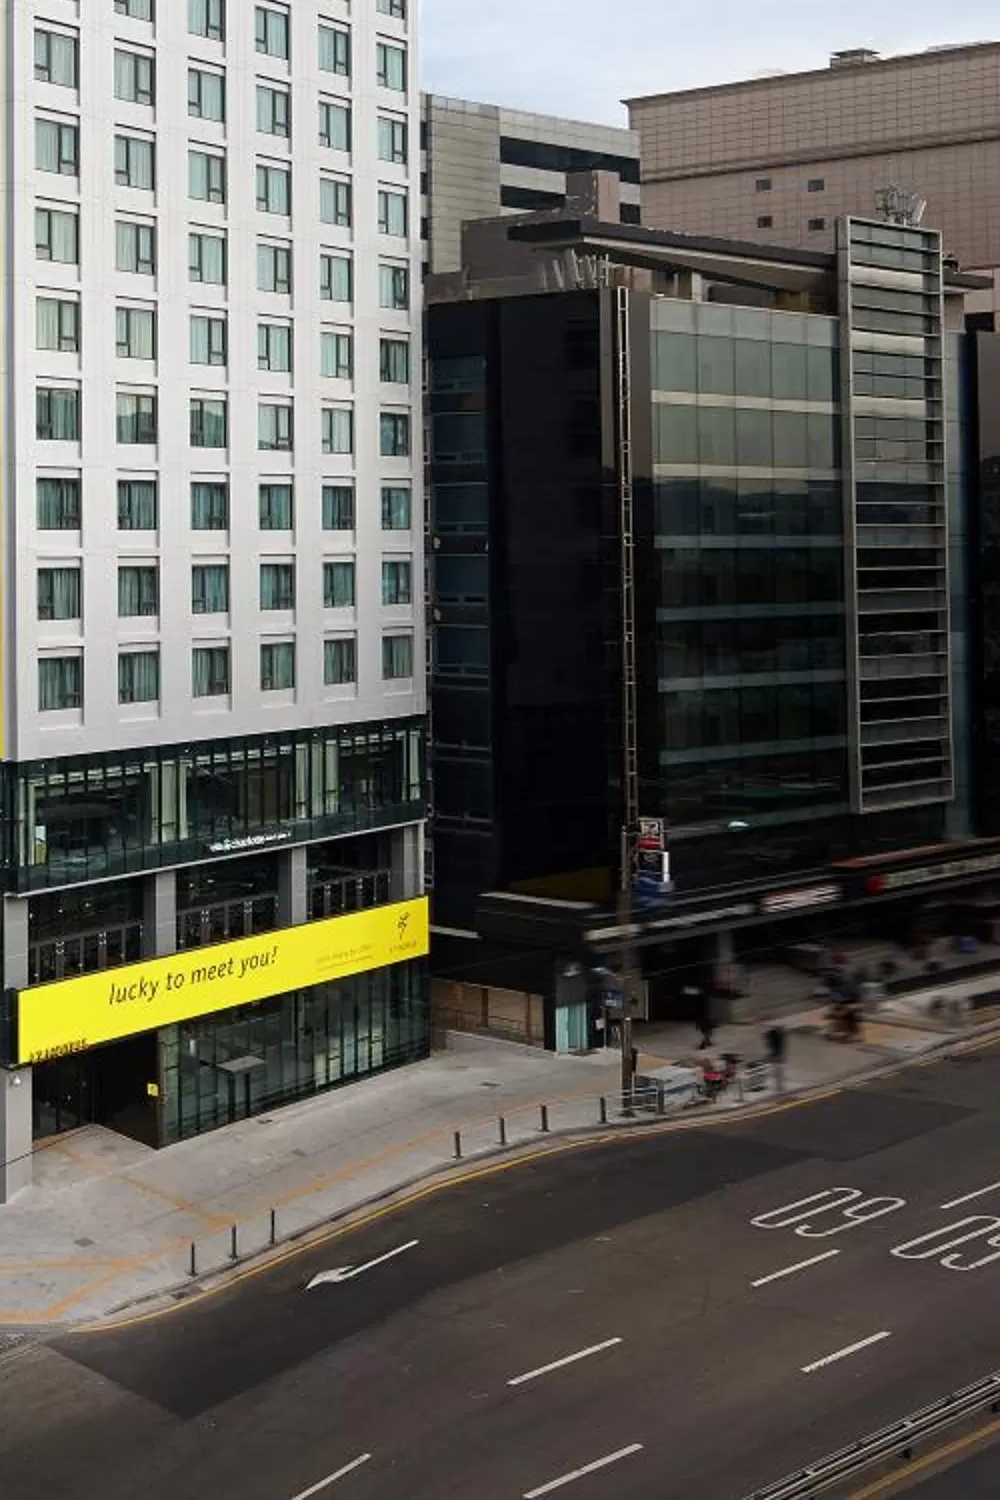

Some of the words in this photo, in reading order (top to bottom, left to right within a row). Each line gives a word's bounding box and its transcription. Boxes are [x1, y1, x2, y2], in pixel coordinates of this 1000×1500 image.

[109, 980, 160, 1006] lucky
[166, 972, 185, 991] to
[189, 956, 234, 985] meet
[238, 946, 279, 979] you!
